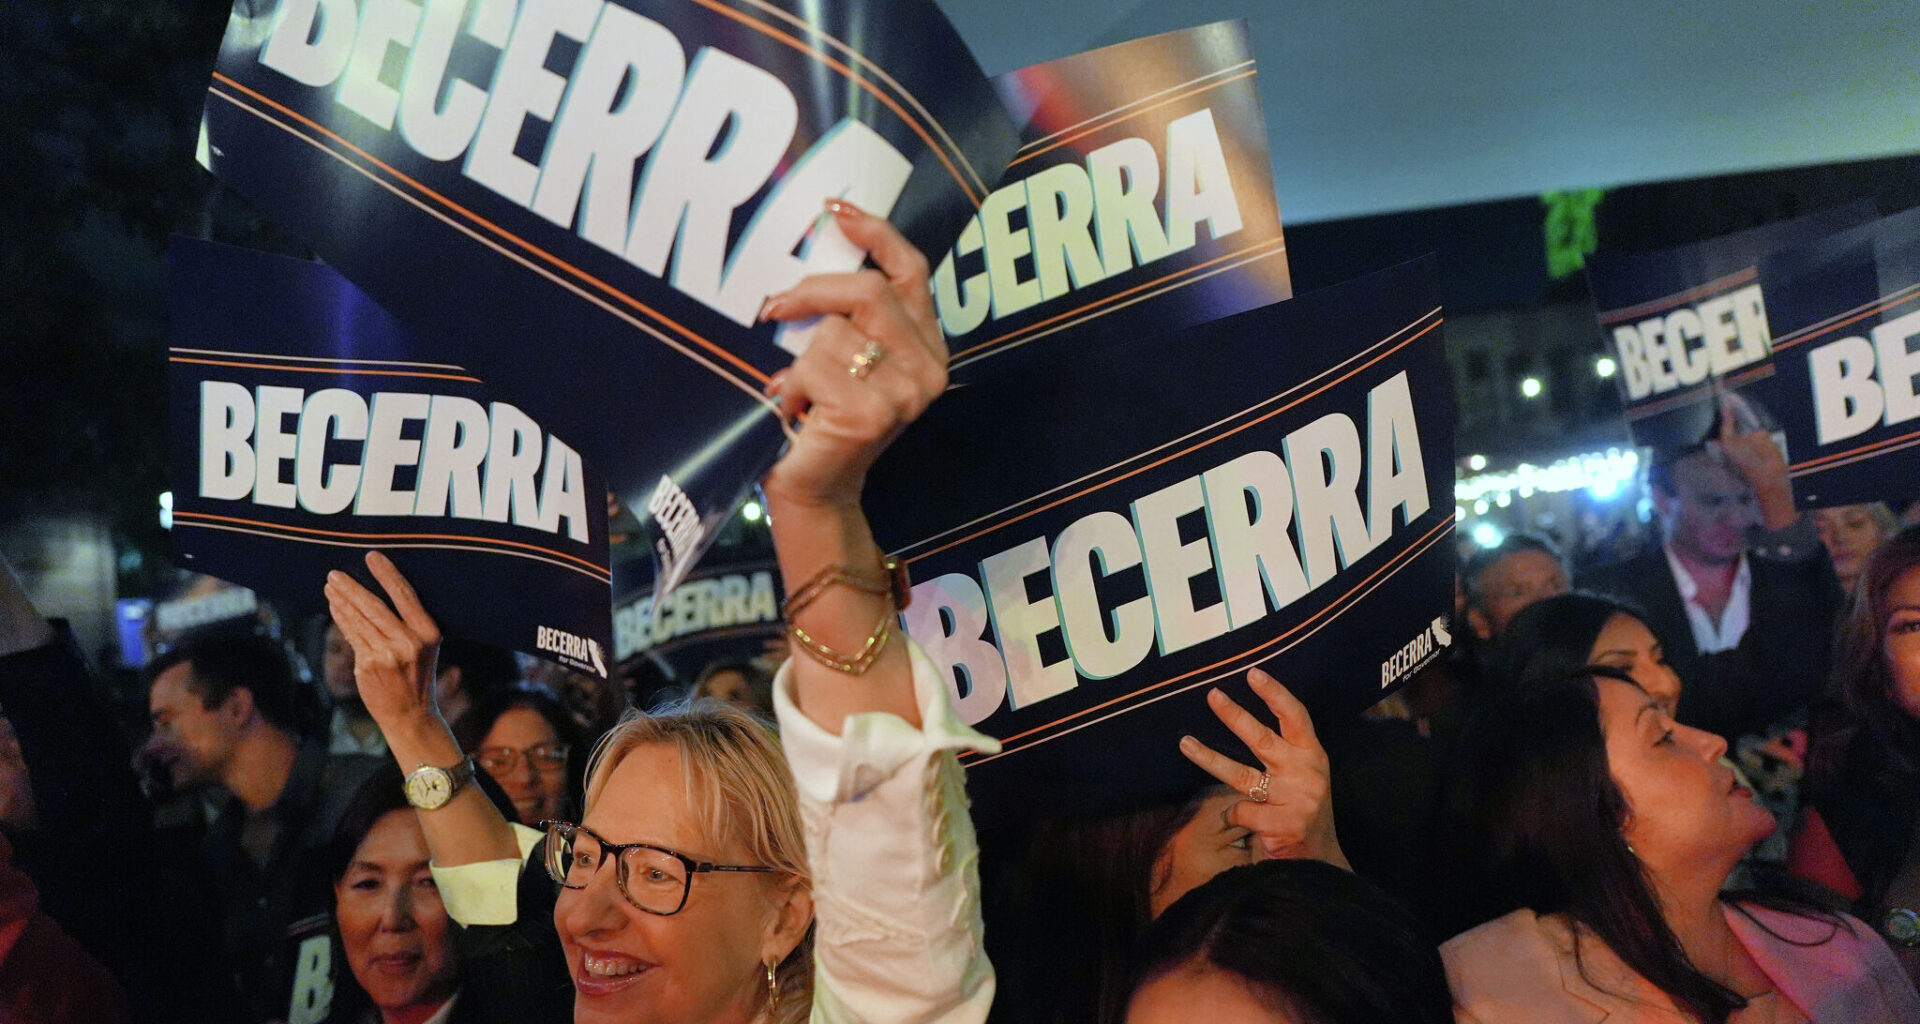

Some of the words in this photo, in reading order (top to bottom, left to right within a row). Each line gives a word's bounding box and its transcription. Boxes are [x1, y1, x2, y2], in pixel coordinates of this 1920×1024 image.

[930, 108, 1244, 338] CERRA
[1807, 309, 1920, 446] BE
[200, 380, 589, 545] BECERRA
[899, 369, 1431, 727] BECERRA
[537, 624, 588, 662] BECERRA
[1382, 627, 1432, 689] BECERRA
